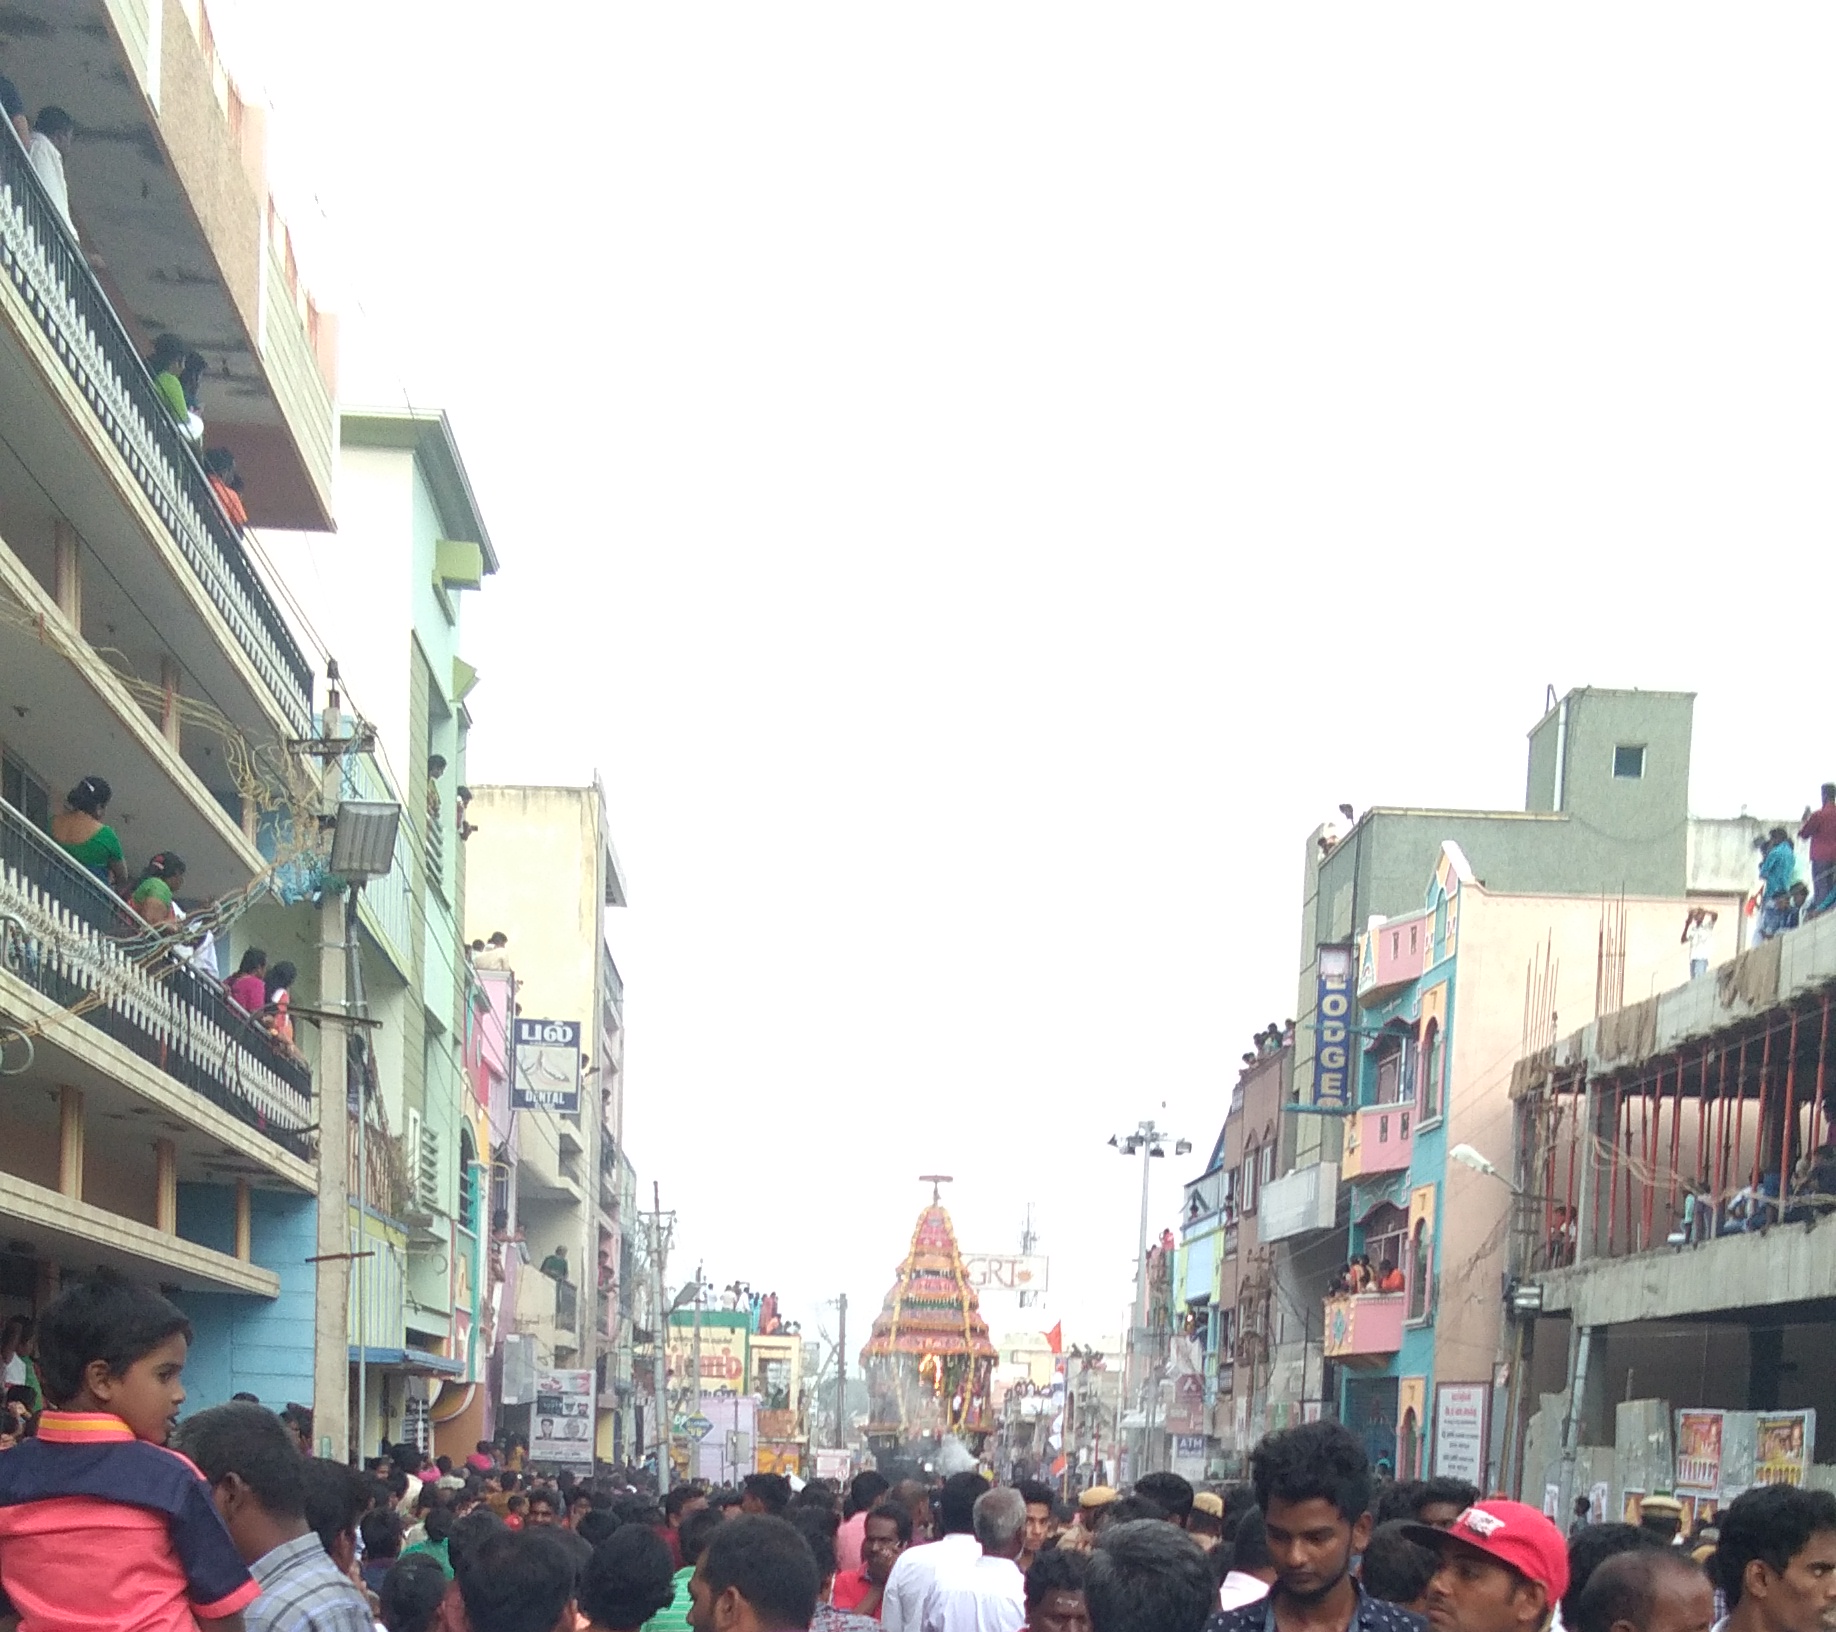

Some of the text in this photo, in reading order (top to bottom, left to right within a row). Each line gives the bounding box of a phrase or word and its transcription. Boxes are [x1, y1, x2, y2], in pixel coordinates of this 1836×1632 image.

[521, 1021, 573, 1043] பல்
[525, 1090, 565, 1105] DENTAL
[965, 1257, 1023, 1288] GRT
[1179, 1437, 1203, 1448] ATM
